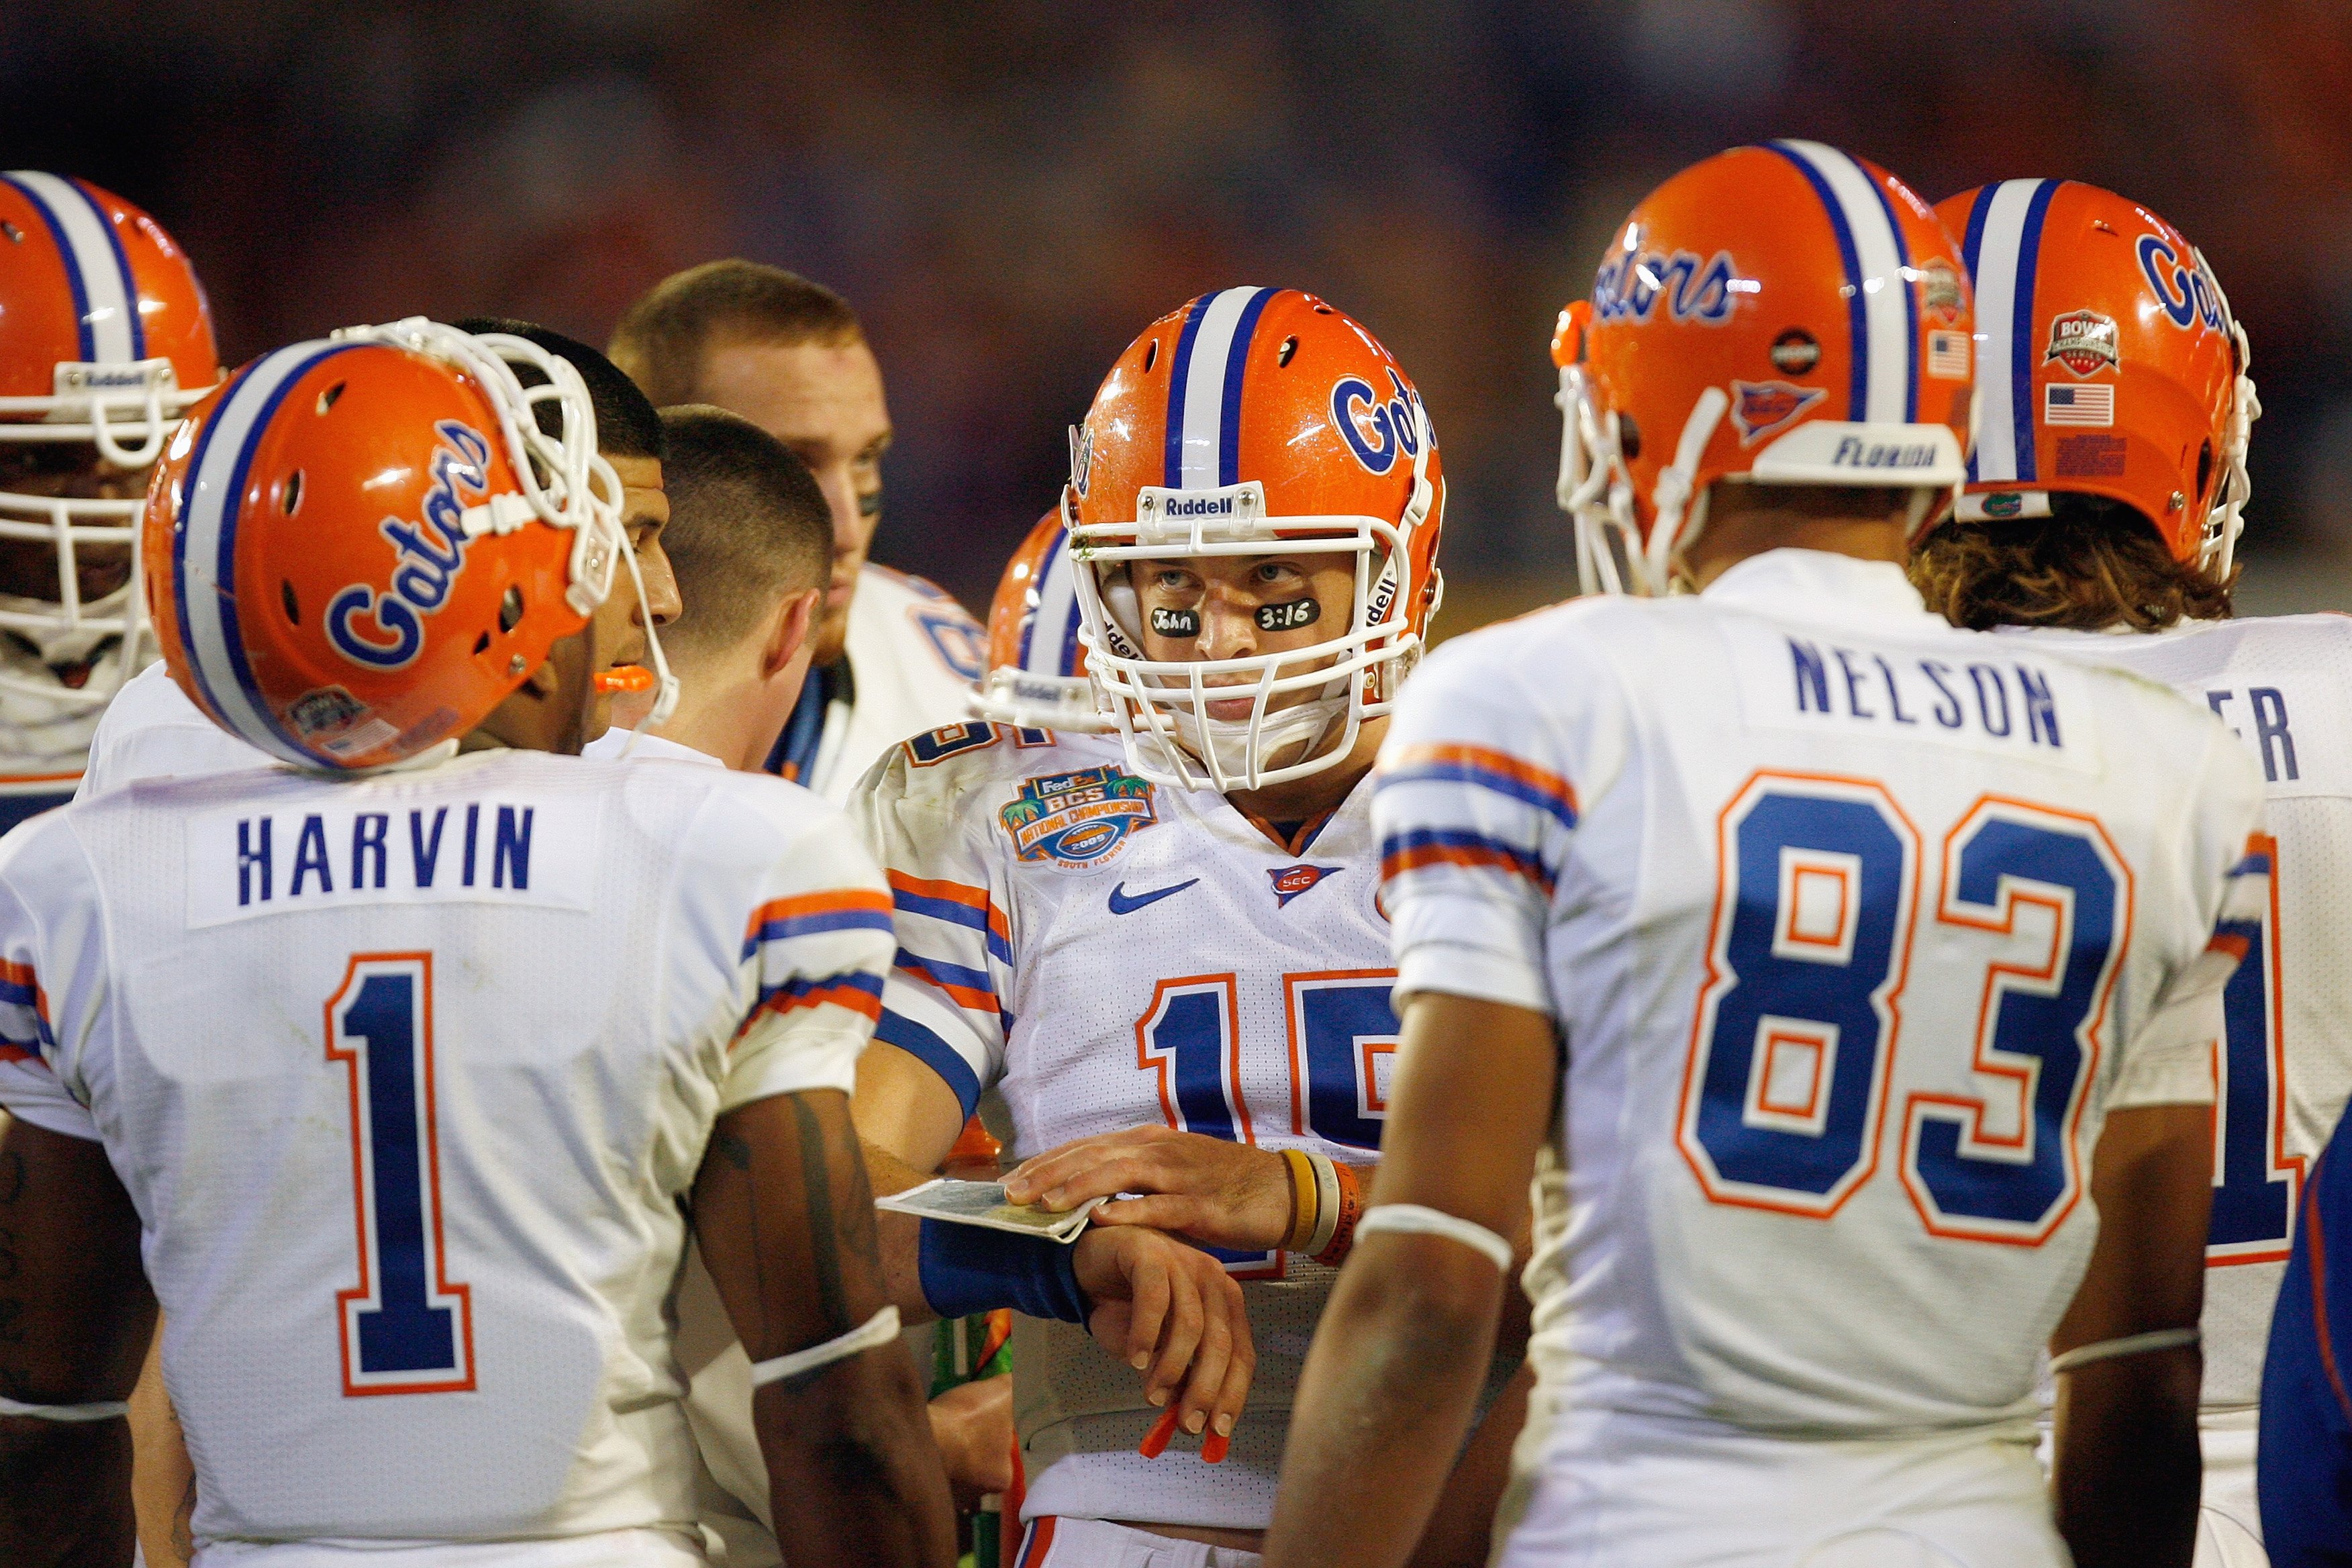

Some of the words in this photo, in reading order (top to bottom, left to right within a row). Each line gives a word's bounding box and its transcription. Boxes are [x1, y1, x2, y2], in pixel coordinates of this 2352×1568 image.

[2060, 320, 2112, 337] BOW
[1166, 497, 1232, 516] Riddell
[324, 419, 492, 669] Gators
[1262, 601, 1310, 629] 3:16
[1367, 577, 1397, 627] dell
[1153, 609, 1192, 631] John
[1787, 636, 2064, 747] NELSON
[1042, 775, 1095, 793] FedEx
[1044, 787, 1105, 813] BCS
[1021, 814, 1067, 845] NATIONAL
[1069, 801, 1144, 824] CHAMPIONSHIP
[236, 802, 535, 905] HARVIN
[1057, 860, 1088, 869] SOUTH
[1093, 840, 1126, 866] FLORIDA
[1071, 834, 1106, 850] 2009
[1283, 877, 1311, 887] SEC
[1674, 767, 2136, 1246] 83
[324, 950, 477, 1398] 1
